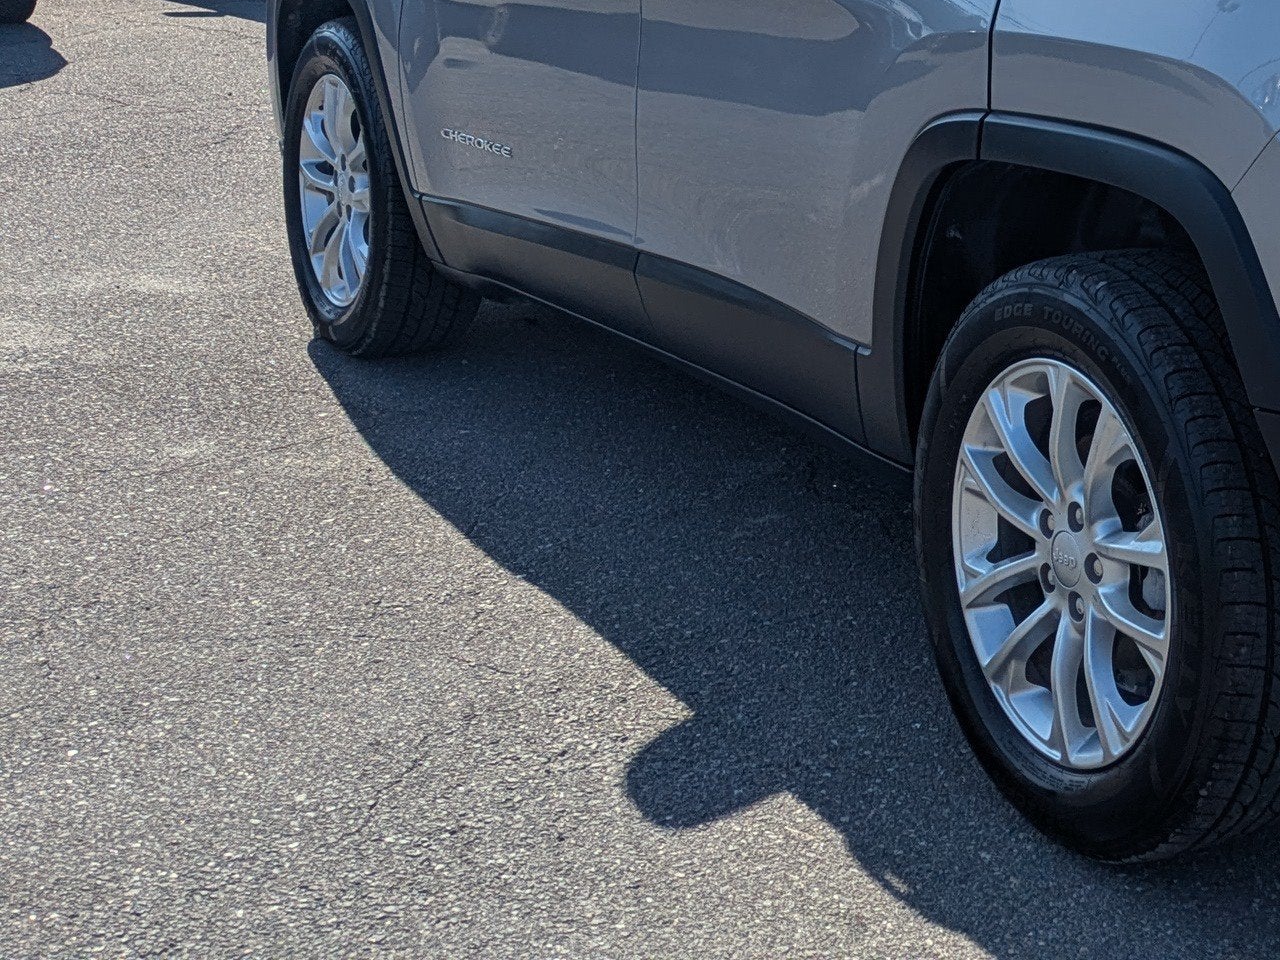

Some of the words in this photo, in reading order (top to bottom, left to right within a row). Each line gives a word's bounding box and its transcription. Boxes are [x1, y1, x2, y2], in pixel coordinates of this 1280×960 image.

[440, 128, 513, 158] CHEROKEE
[994, 302, 1034, 322] EDGE
[1043, 305, 1109, 361] TOURING
